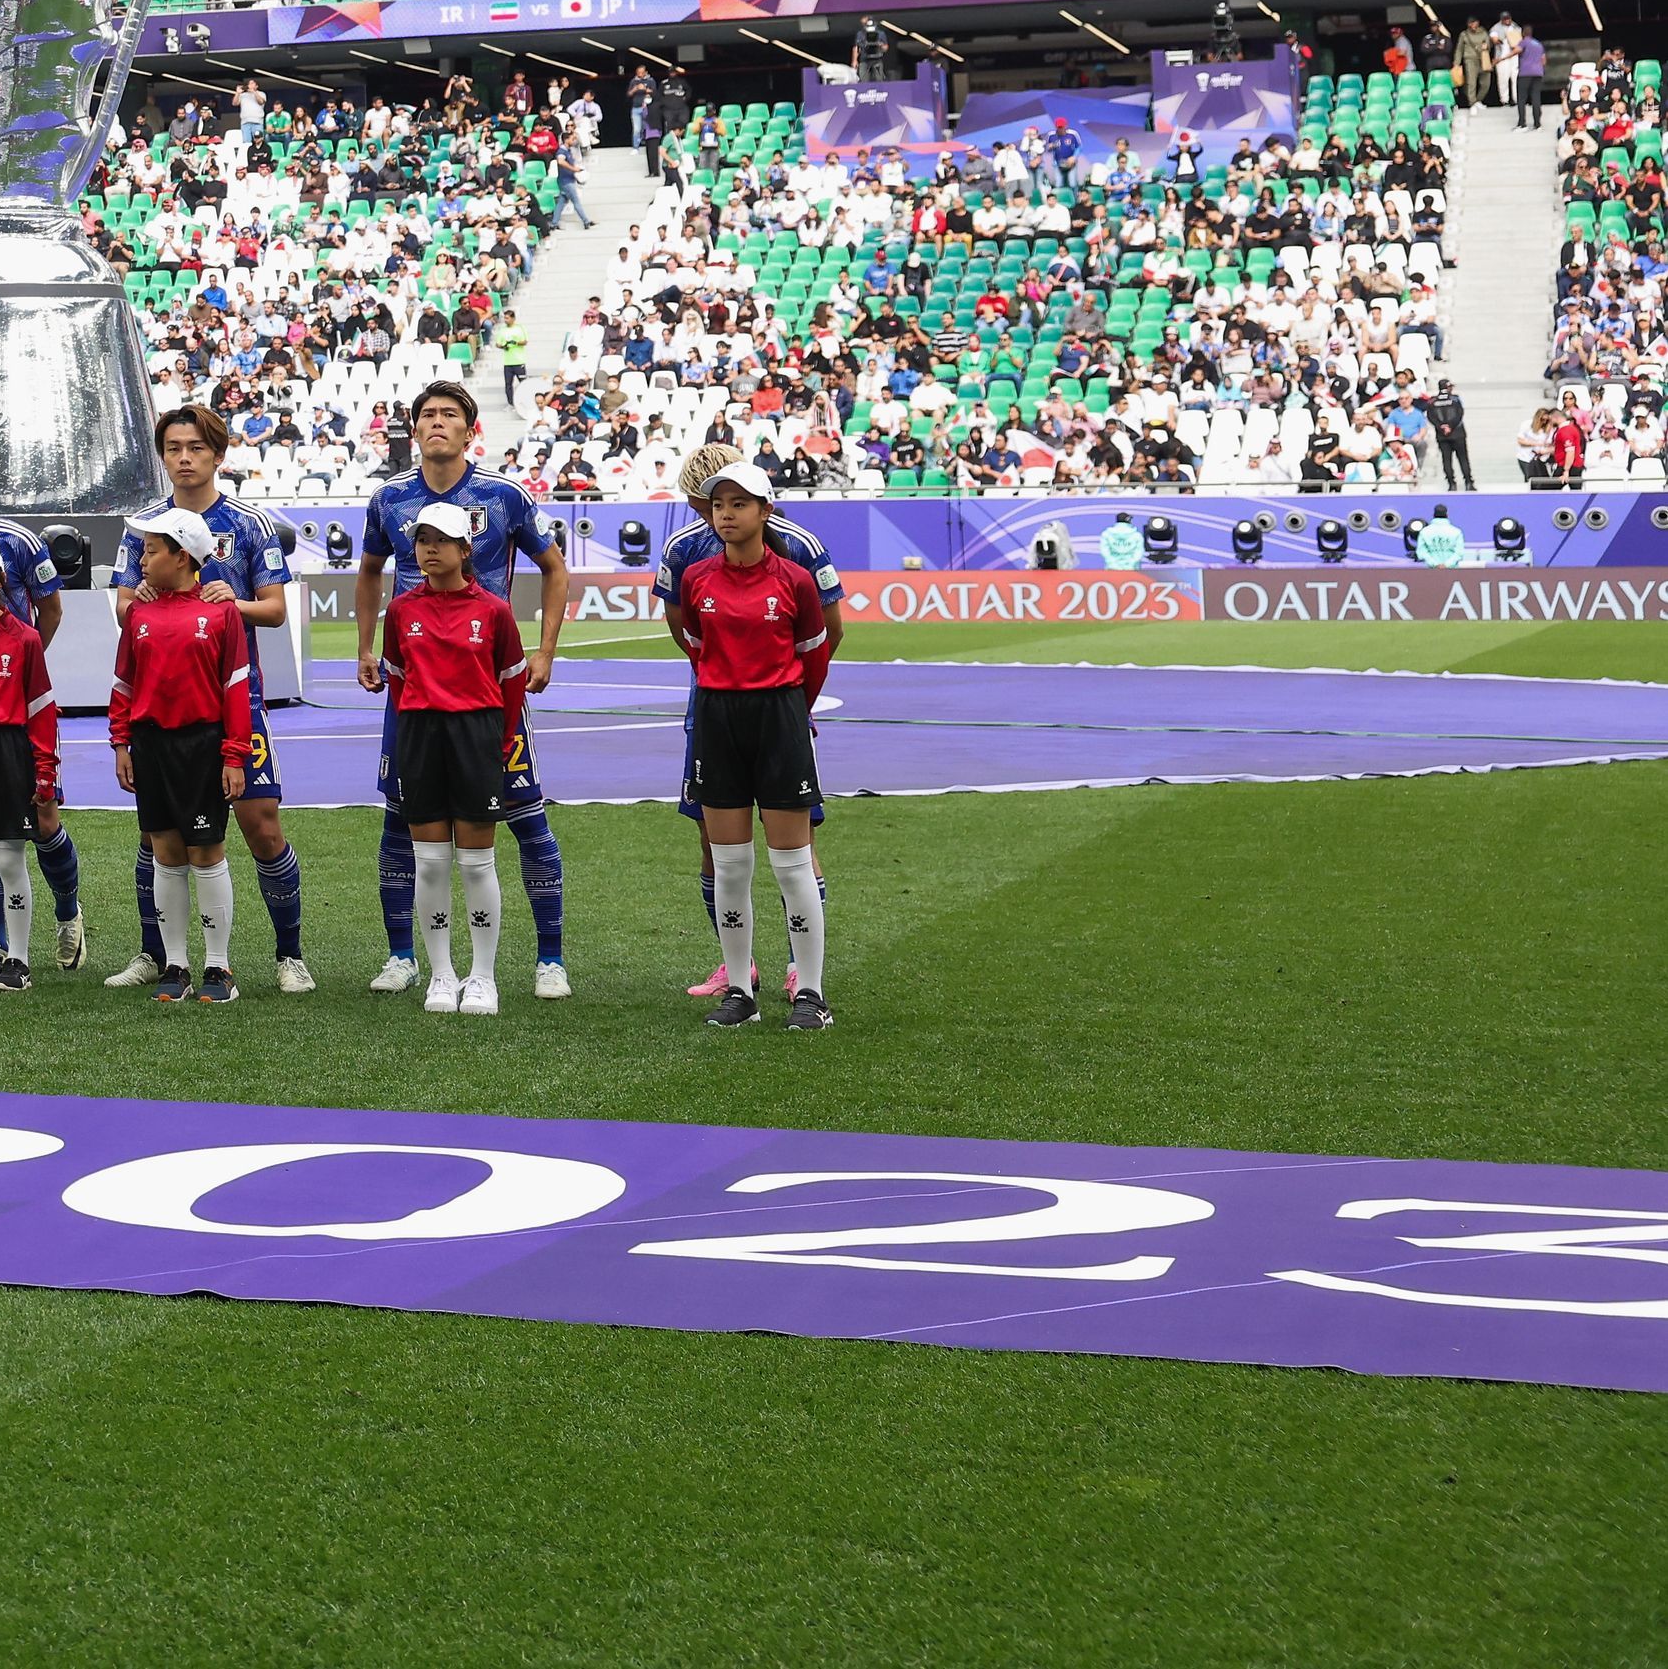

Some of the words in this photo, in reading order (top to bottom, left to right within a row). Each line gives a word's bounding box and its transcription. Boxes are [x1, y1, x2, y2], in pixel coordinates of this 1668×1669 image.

[574, 585, 665, 621] ASI
[879, 582, 1046, 623] QATAR
[1223, 580, 1415, 623] QATAR
[249, 732, 268, 769] 9
[507, 734, 530, 772] 2
[471, 920, 492, 929] KELME
[721, 921, 744, 930] KELME
